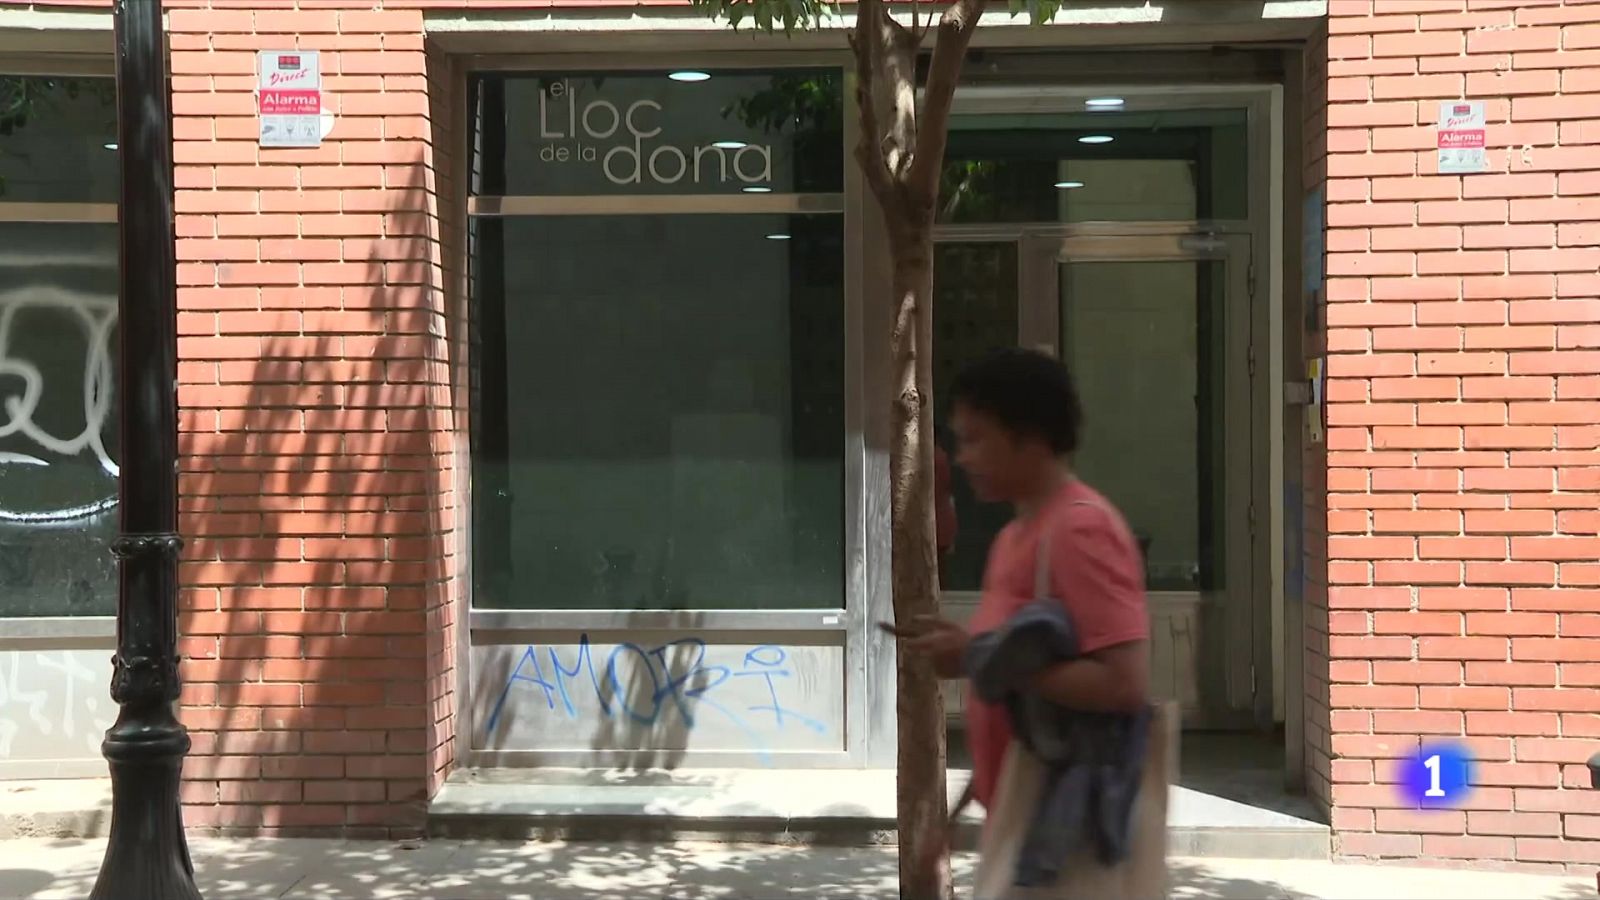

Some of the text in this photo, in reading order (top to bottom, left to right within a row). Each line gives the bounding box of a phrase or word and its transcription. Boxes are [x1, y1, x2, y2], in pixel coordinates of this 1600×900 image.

[549, 78, 569, 97] el
[263, 93, 318, 105] Alarma
[539, 86, 663, 139] Lloc
[1441, 132, 1483, 142] Alarma
[539, 143, 597, 162] de la
[602, 135, 772, 184] dona
